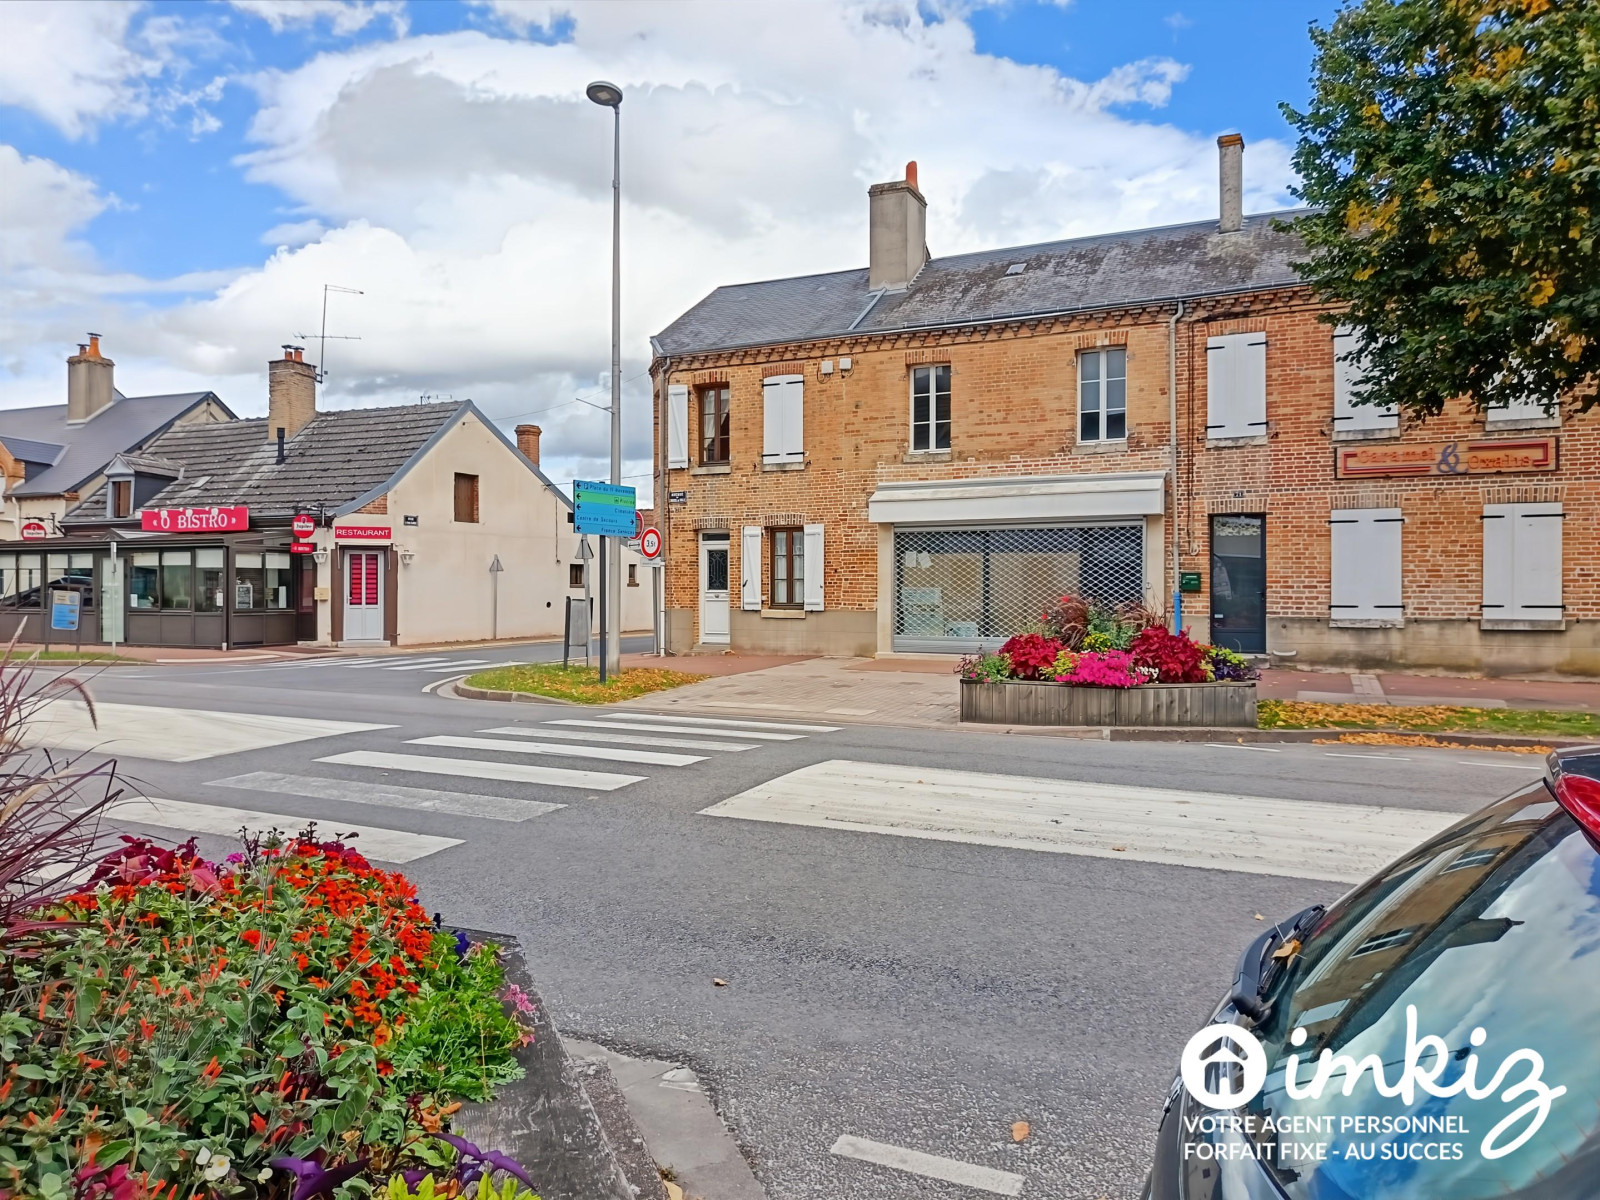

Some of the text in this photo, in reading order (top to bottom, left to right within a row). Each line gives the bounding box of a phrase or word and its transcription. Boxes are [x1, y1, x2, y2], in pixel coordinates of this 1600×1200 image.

[1357, 447, 1435, 464] Caramel
[1436, 441, 1468, 474] &
[178, 513, 228, 529] BISTRO
[336, 528, 390, 536] RESTAURANT
